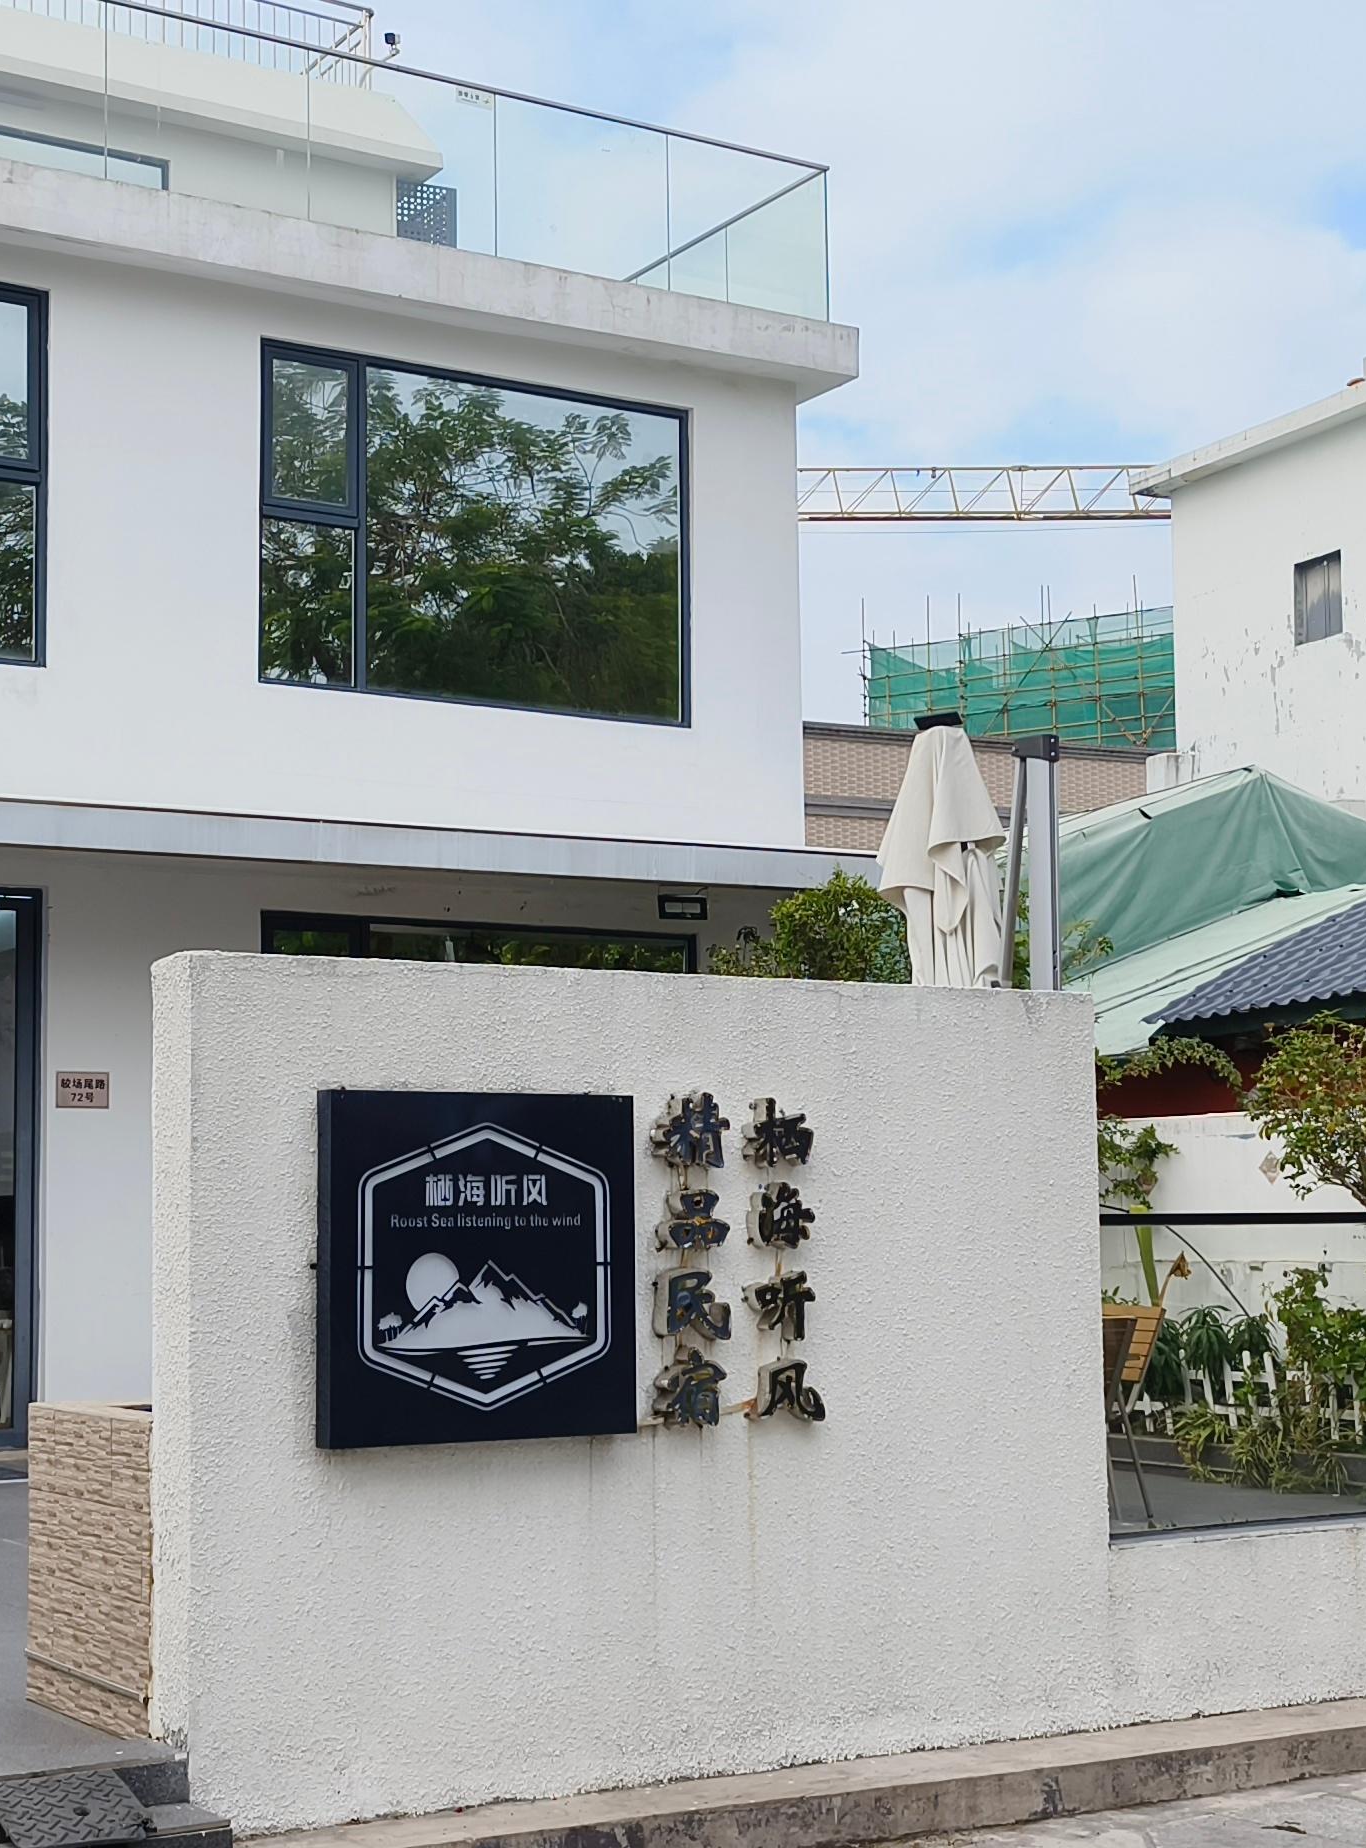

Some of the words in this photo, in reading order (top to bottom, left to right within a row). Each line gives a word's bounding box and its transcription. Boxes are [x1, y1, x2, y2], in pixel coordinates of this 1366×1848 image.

[71, 1092, 94, 1102] 72号
[425, 1173, 548, 1207] 栖海听风
[390, 1214, 428, 1228] Roost
[431, 1213, 455, 1228] Sea
[457, 1212, 512, 1230] listening
[515, 1215, 527, 1227] to
[529, 1214, 549, 1227] the
[552, 1213, 581, 1227] wind
[651, 1092, 731, 1427] 精品民宿
[742, 1097, 825, 1421] 栖海听风
